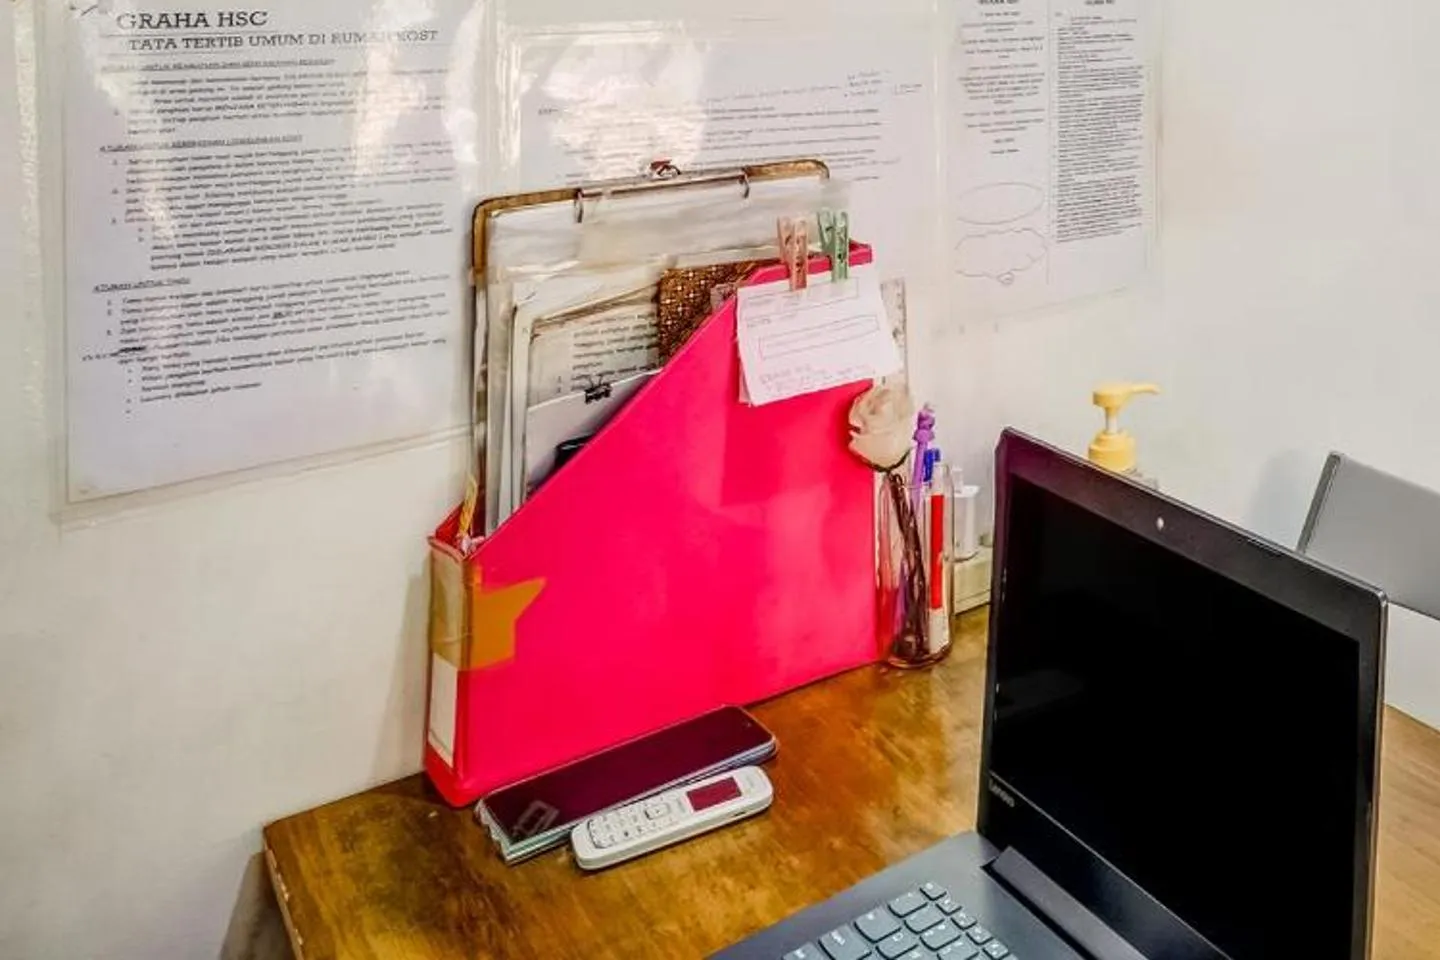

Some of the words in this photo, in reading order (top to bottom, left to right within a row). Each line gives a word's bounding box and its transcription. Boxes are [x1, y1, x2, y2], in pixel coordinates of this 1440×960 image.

[116, 12, 210, 29] GRAHA
[217, 11, 268, 27] HSC
[128, 38, 178, 50] TATA
[181, 36, 243, 49] TERTIB
[248, 33, 304, 48] UMUM
[308, 33, 325, 45] DI
